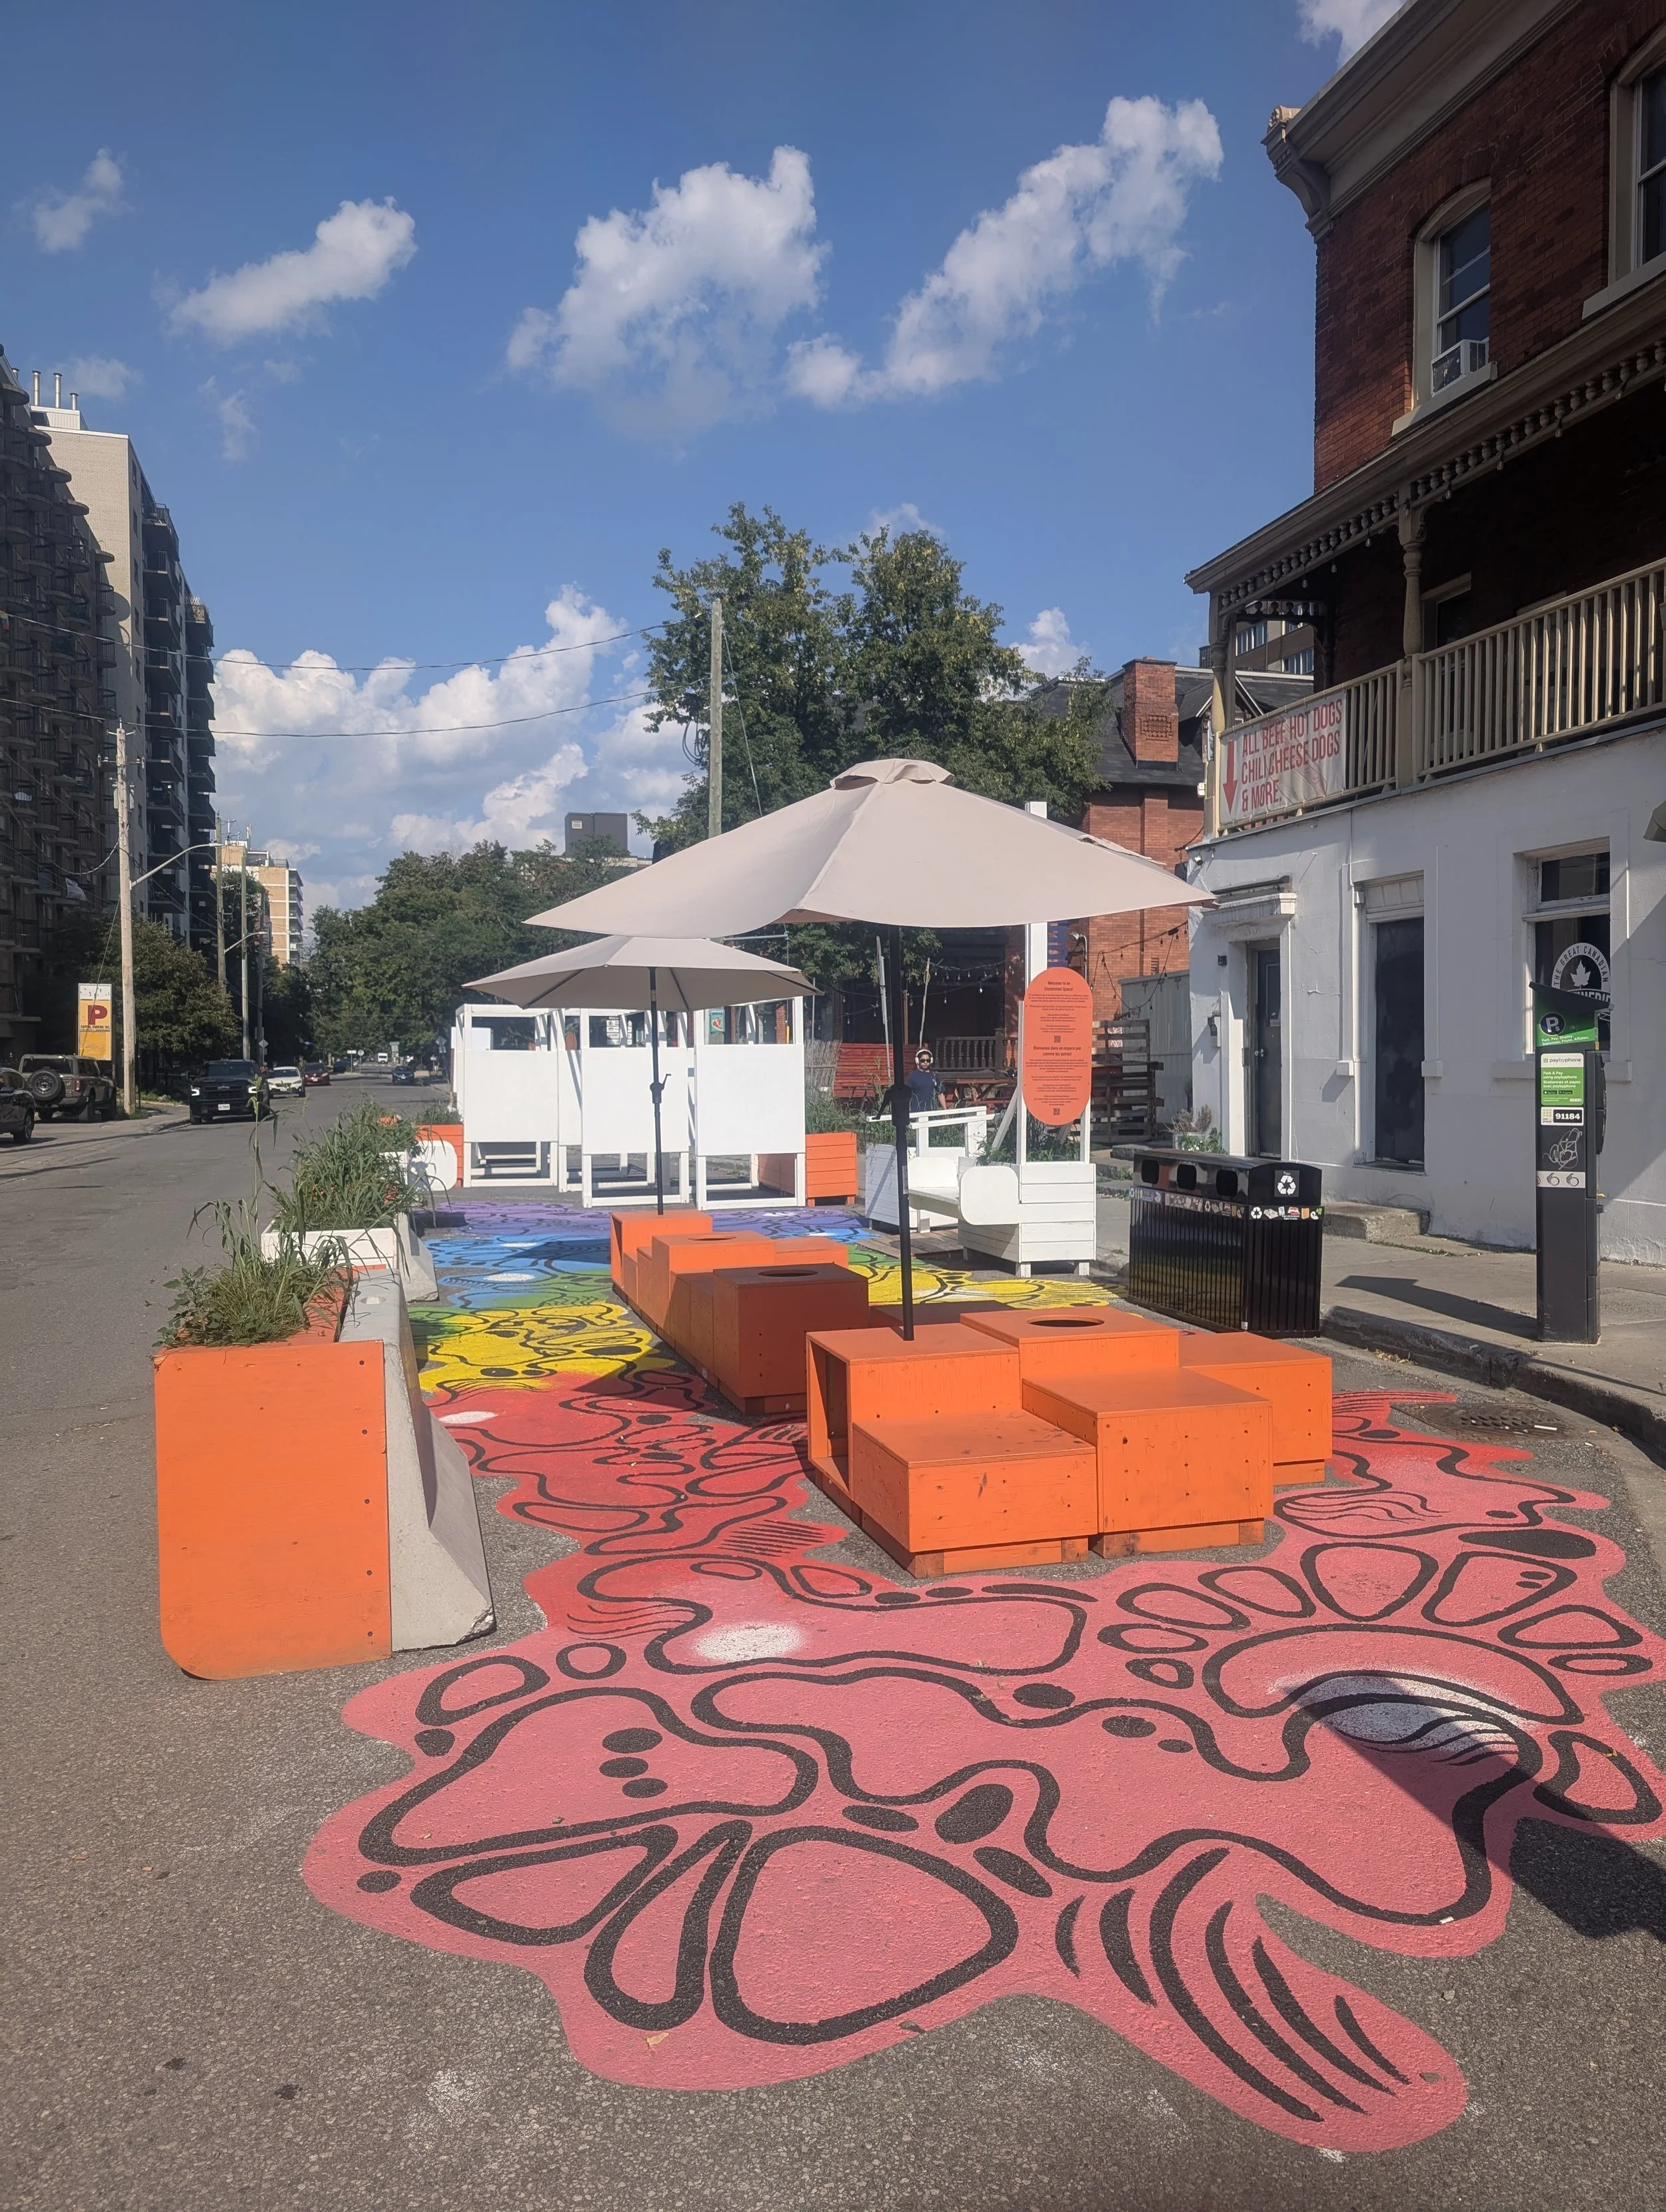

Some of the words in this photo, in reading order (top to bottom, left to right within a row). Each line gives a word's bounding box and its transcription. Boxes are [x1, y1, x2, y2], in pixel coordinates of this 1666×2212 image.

[1242, 731, 1259, 758] ALL
[1262, 720, 1286, 750] BEEF
[1290, 711, 1311, 740] HOT
[1313, 698, 1343, 732] DOGS
[1242, 754, 1267, 785] CHILI
[1268, 741, 1309, 776] CHEESE
[1311, 730, 1341, 763] DOGS
[1242, 789, 1248, 812] &
[1560, 945, 1580, 965] GREAT
[1583, 945, 1609, 983] CANADIAN
[87, 1005, 107, 1025] P
